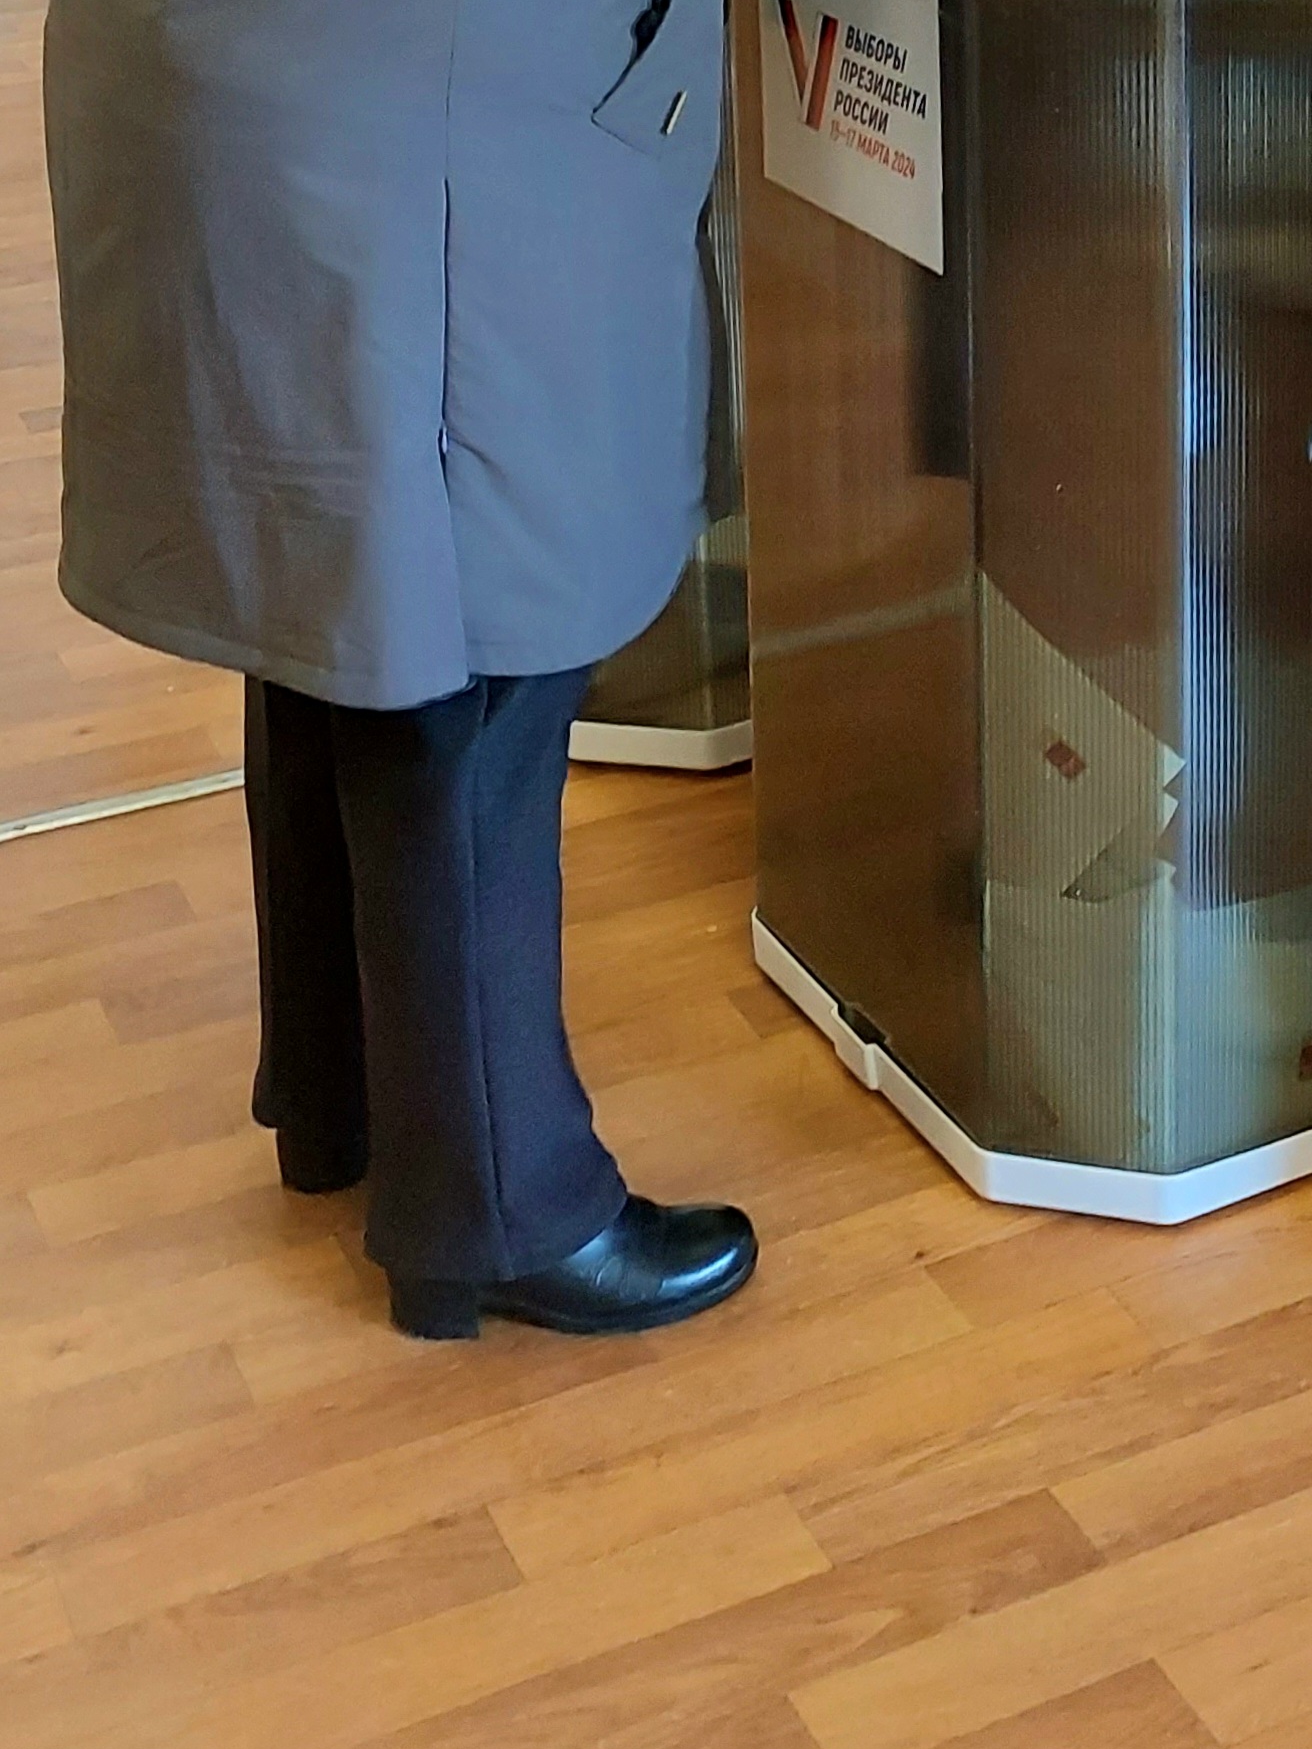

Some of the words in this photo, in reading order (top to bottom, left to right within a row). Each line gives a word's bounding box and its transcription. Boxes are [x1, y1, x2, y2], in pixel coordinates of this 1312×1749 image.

[845, 24, 907, 74] ВЫБОРЫ
[839, 58, 927, 119] ПРЕЗИДЕНТА
[833, 92, 889, 135] РОССИИ
[857, 133, 890, 166] МАРТА
[892, 150, 916, 179] 2024
